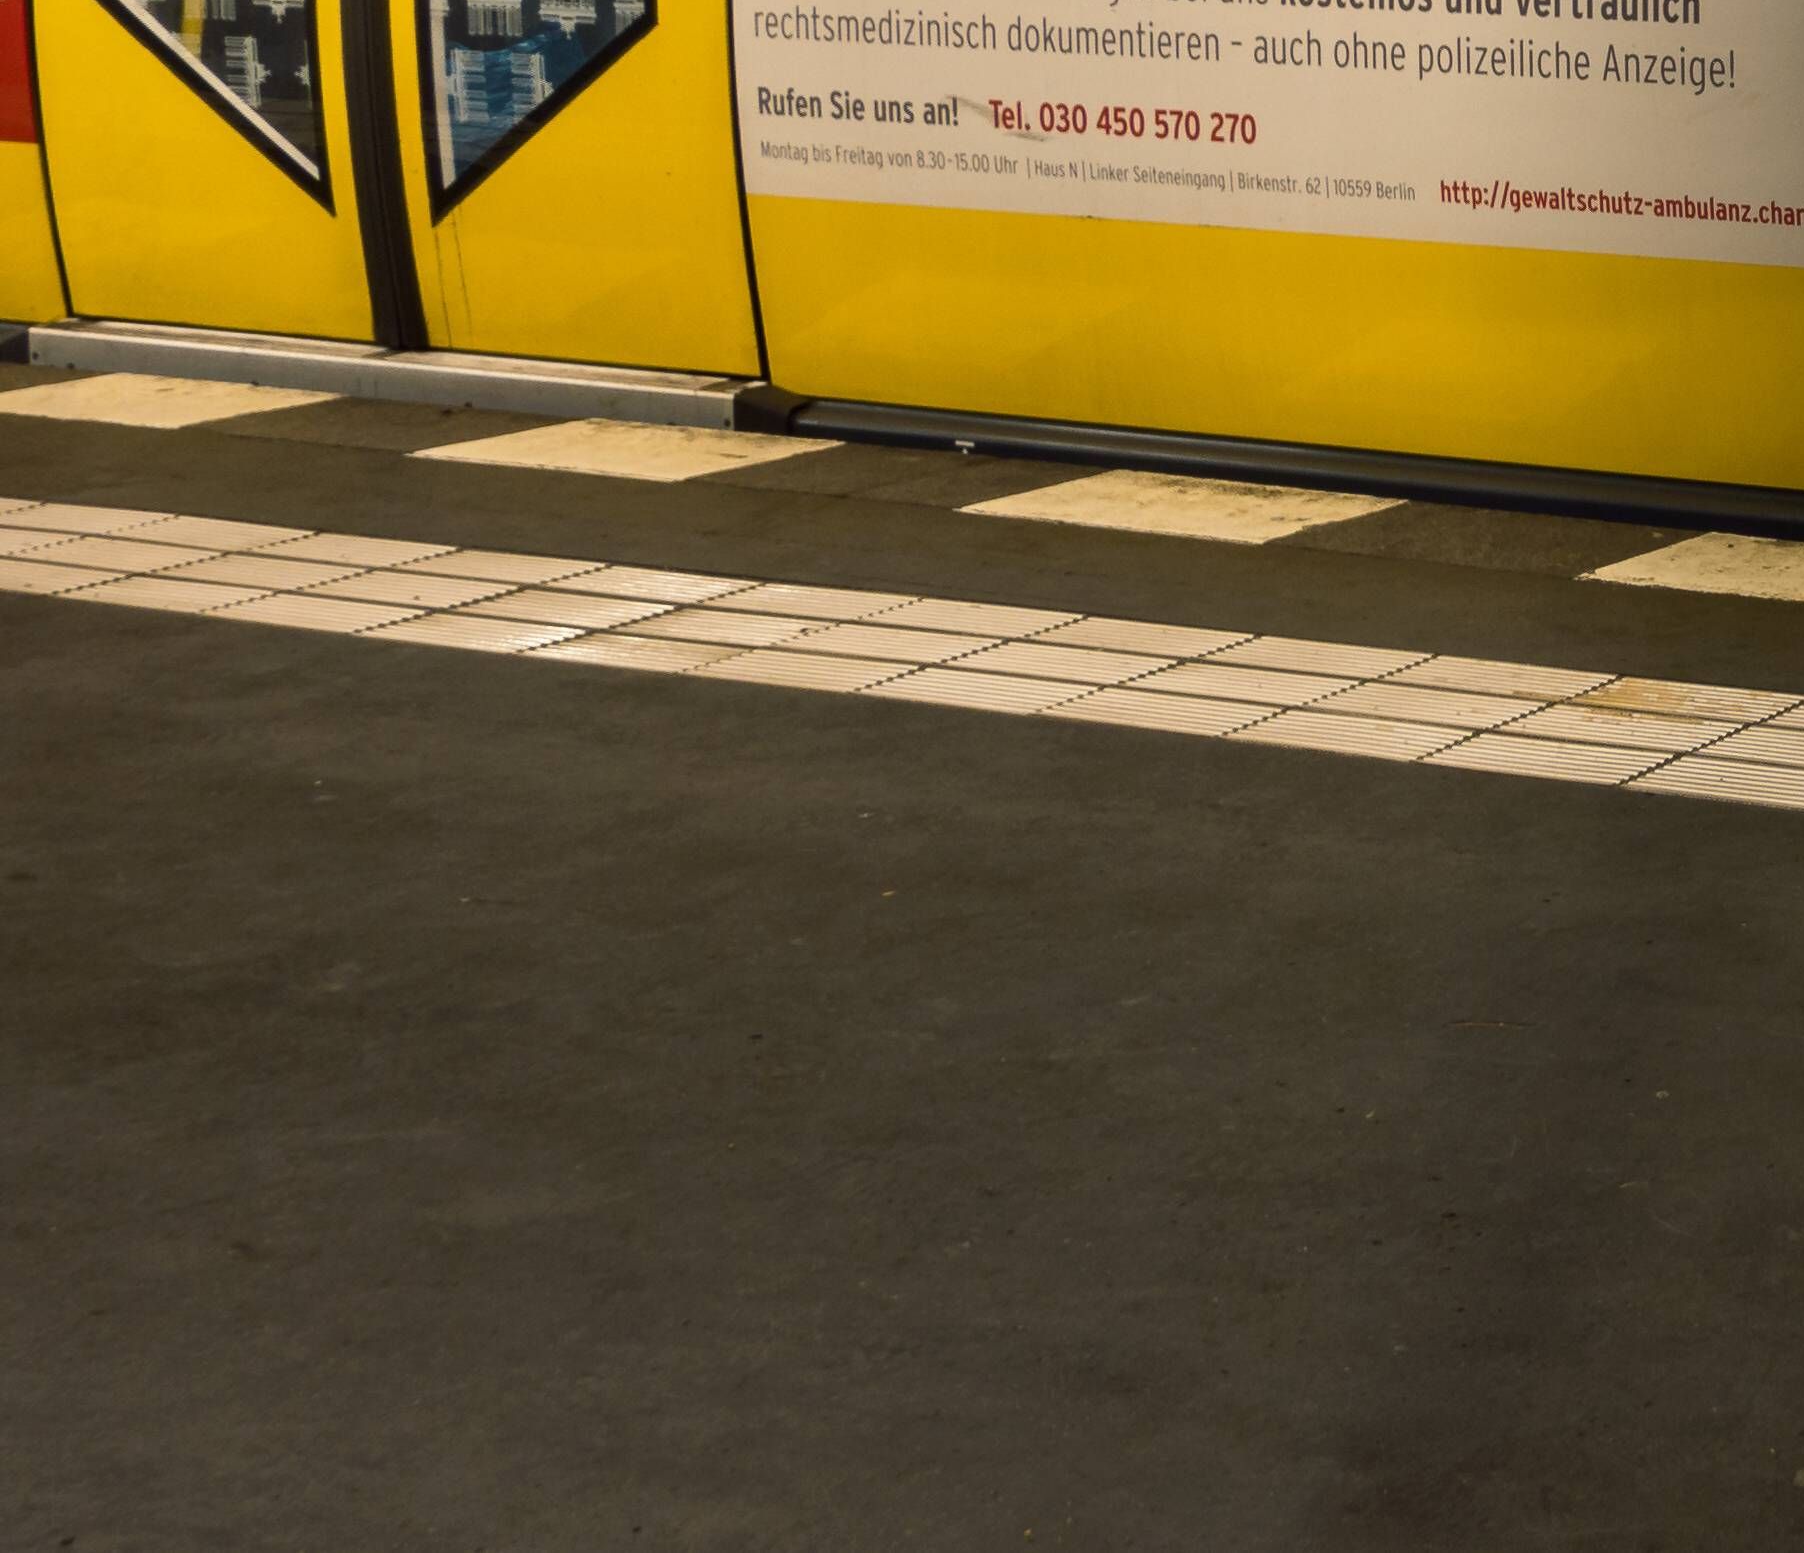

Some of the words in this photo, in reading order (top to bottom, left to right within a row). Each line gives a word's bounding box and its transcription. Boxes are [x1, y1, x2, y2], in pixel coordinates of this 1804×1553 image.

[755, 6, 996, 49] rechtsmedizinisch
[1008, 16, 1219, 61] dokumentieren
[1254, 30, 1321, 66] auch
[1334, 31, 1405, 71] ohne
[1419, 37, 1590, 81] polizeiliche
[1603, 44, 1734, 96] Anzeige!
[758, 86, 822, 118] Rufen
[830, 90, 865, 121] Sie
[874, 100, 914, 123] uns
[923, 98, 959, 127] an!
[988, 99, 1032, 131] Tel.
[1040, 102, 1087, 134] 030
[1096, 106, 1145, 137] 450
[1155, 109, 1200, 141] 570
[1210, 112, 1256, 145] 270
[761, 142, 808, 164] Montag
[813, 145, 831, 162] bis
[836, 146, 883, 169] Freitag
[888, 153, 912, 166] von
[994, 156, 1017, 174] Uhr
[1035, 161, 1065, 177] Haus
[1069, 162, 1077, 178] N
[1090, 163, 1128, 181] Linker
[1133, 166, 1225, 191] Seiteneingang
[1238, 173, 1301, 192] Birkenstr.
[1306, 177, 1320, 194] 62
[1334, 179, 1371, 197] 10559
[1376, 182, 1415, 200] Berlin
